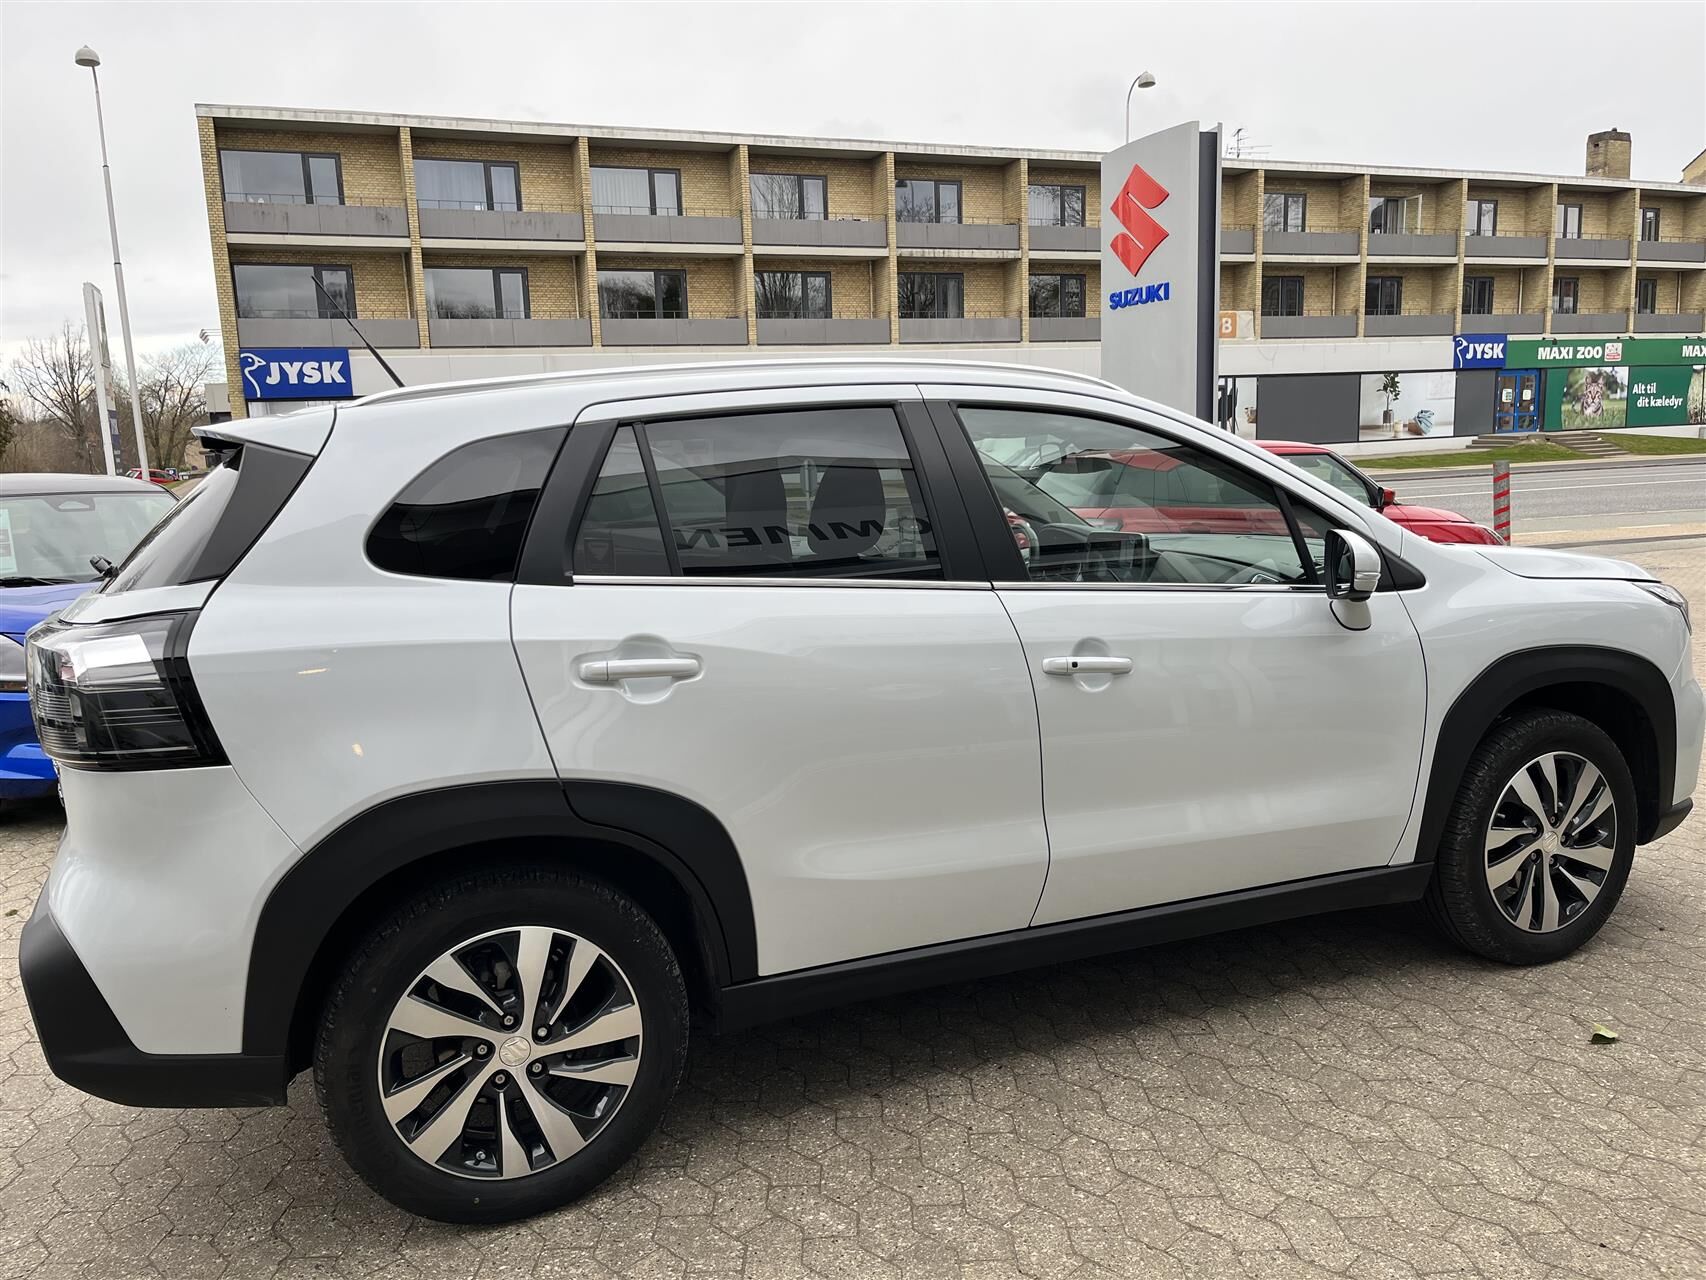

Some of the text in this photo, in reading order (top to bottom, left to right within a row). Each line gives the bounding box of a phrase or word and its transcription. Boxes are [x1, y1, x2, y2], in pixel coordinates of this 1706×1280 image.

[1109, 282, 1170, 310] SUZUKI
[1465, 342, 1504, 360] JYSK
[1537, 346, 1573, 360] MAXI
[1576, 345, 1602, 359] ZOO
[265, 361, 346, 385] JYSK
[1632, 382, 1657, 394] Alt til
[1637, 395, 1683, 409] dit kæledyr
